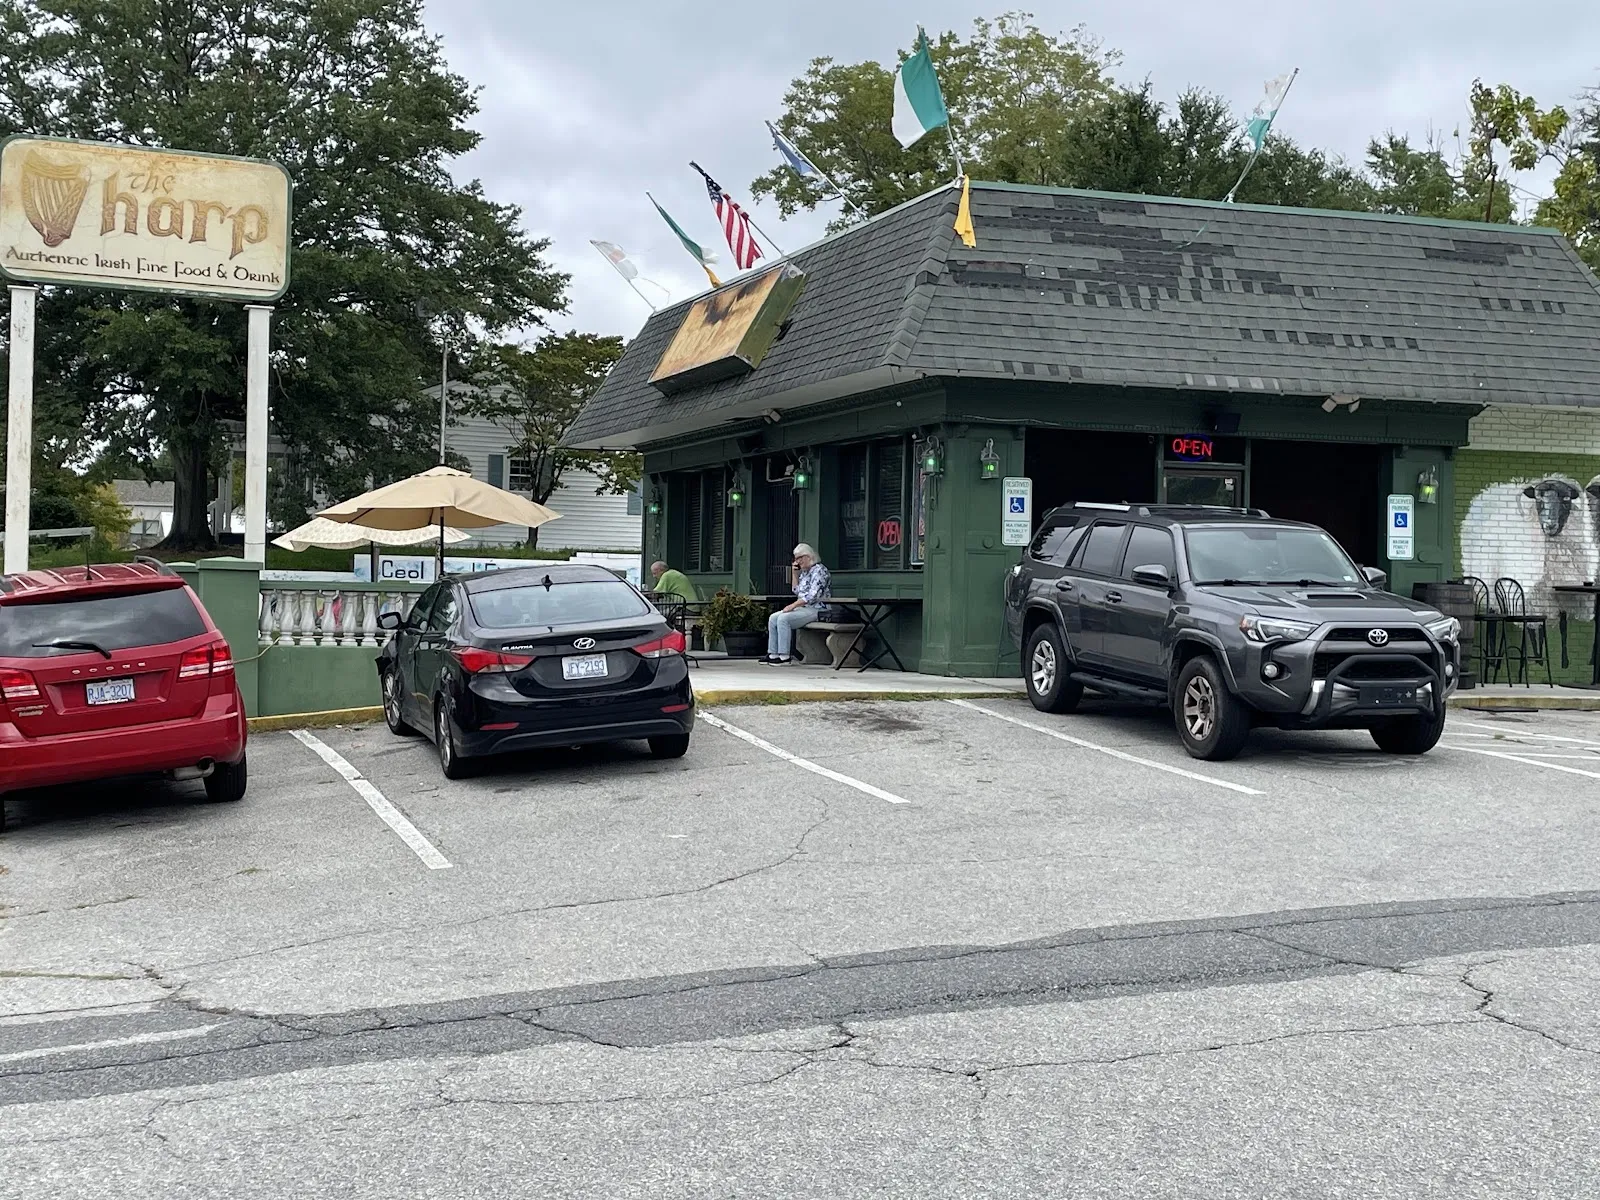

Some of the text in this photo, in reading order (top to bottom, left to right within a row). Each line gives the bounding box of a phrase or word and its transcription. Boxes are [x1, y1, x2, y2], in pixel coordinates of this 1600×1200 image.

[127, 171, 176, 194] the
[100, 170, 269, 261] harp
[6, 246, 280, 284] Authentic Irish Fine Food & Drink
[1172, 438, 1213, 456] OPEN
[879, 521, 901, 545] OPEN
[382, 560, 424, 579] Ceol
[88, 684, 132, 700] RJA-3207
